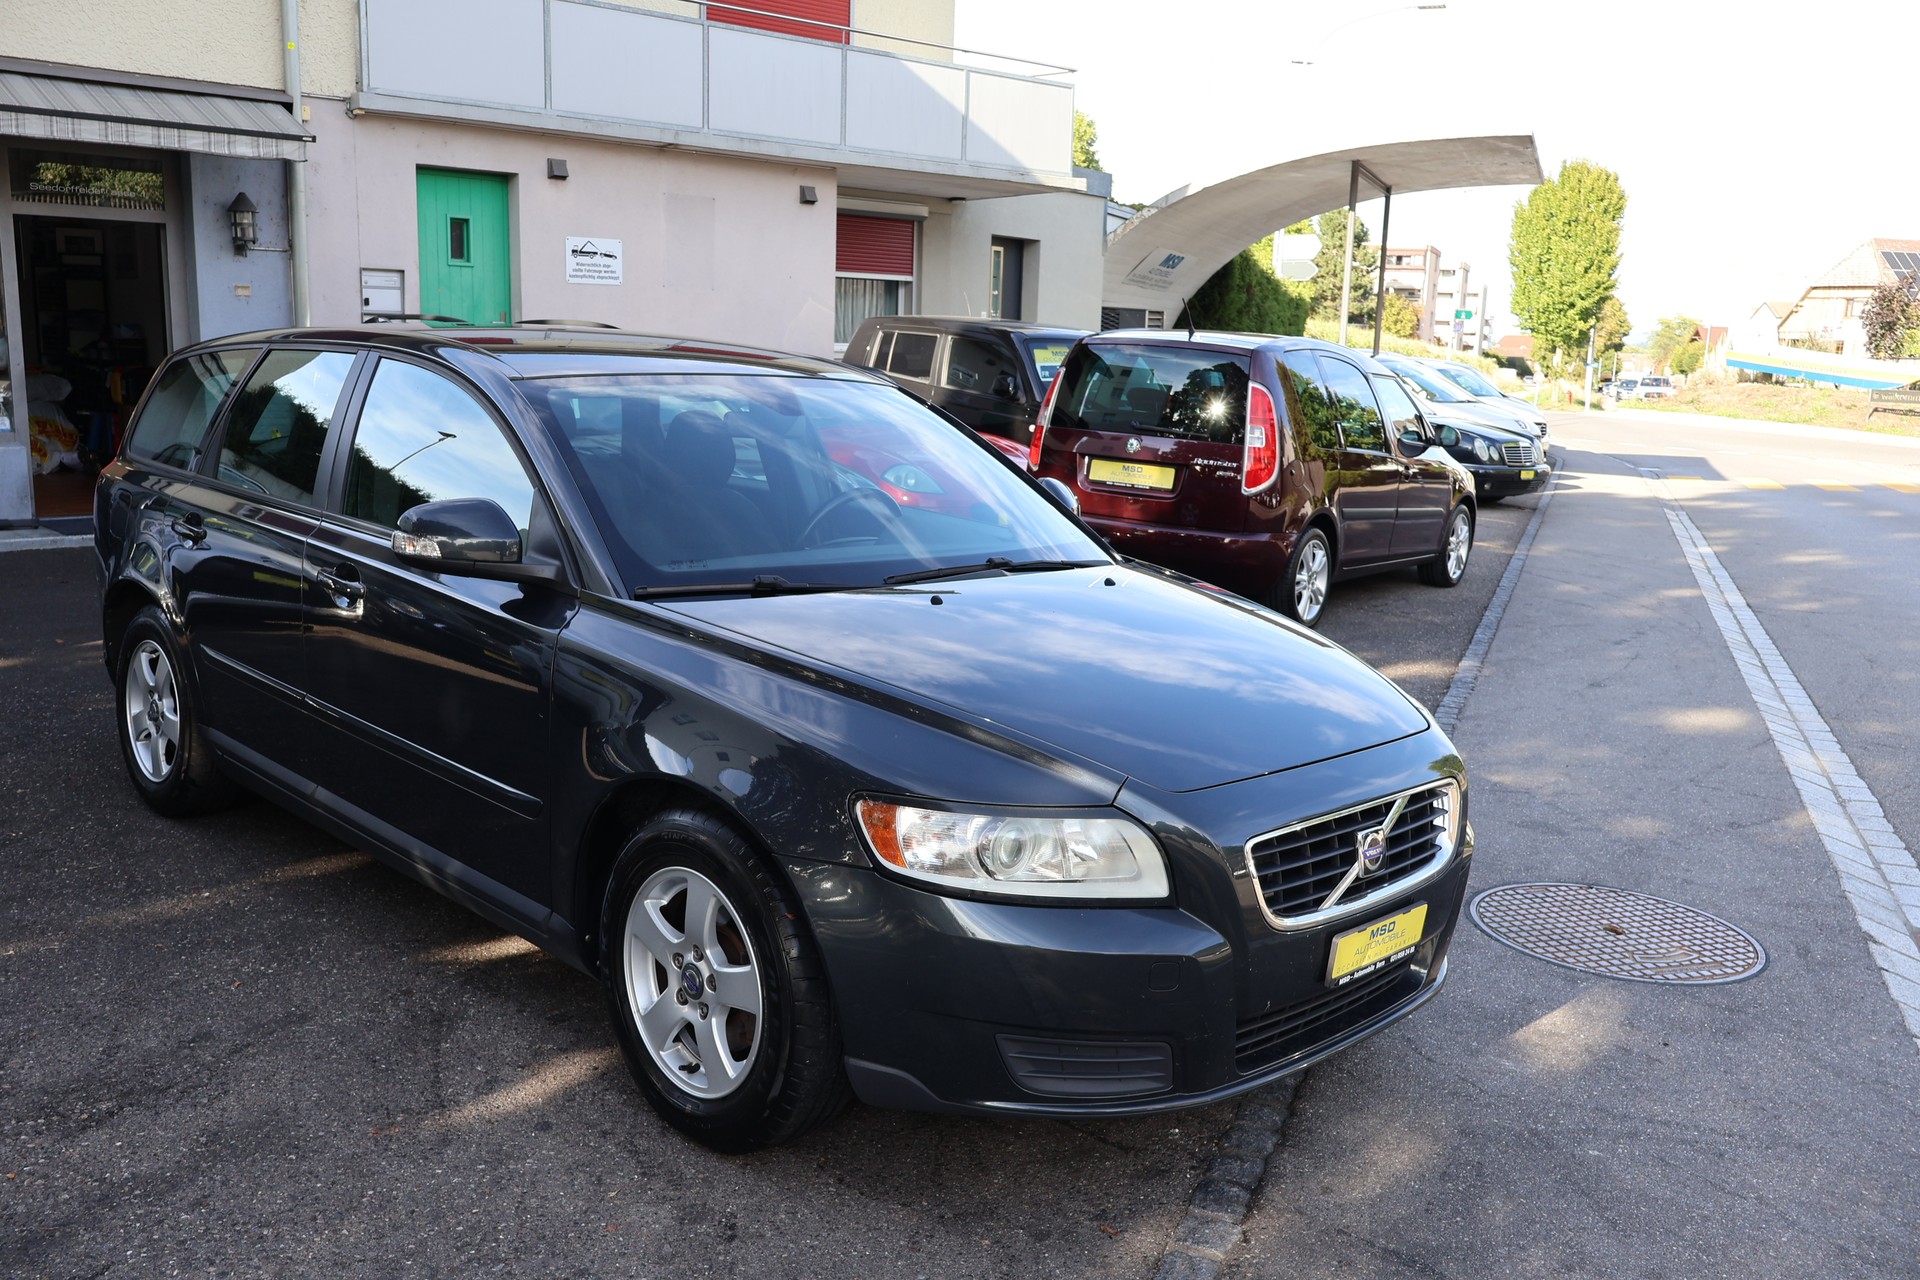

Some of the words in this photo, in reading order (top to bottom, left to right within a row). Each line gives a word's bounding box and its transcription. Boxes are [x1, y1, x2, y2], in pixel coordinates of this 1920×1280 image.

[1110, 470, 1153, 480] AUTOMOBILE
[1121, 464, 1143, 474] MSD
[1368, 920, 1397, 941] MSD
[1354, 928, 1407, 957] AUTOMOBILE
